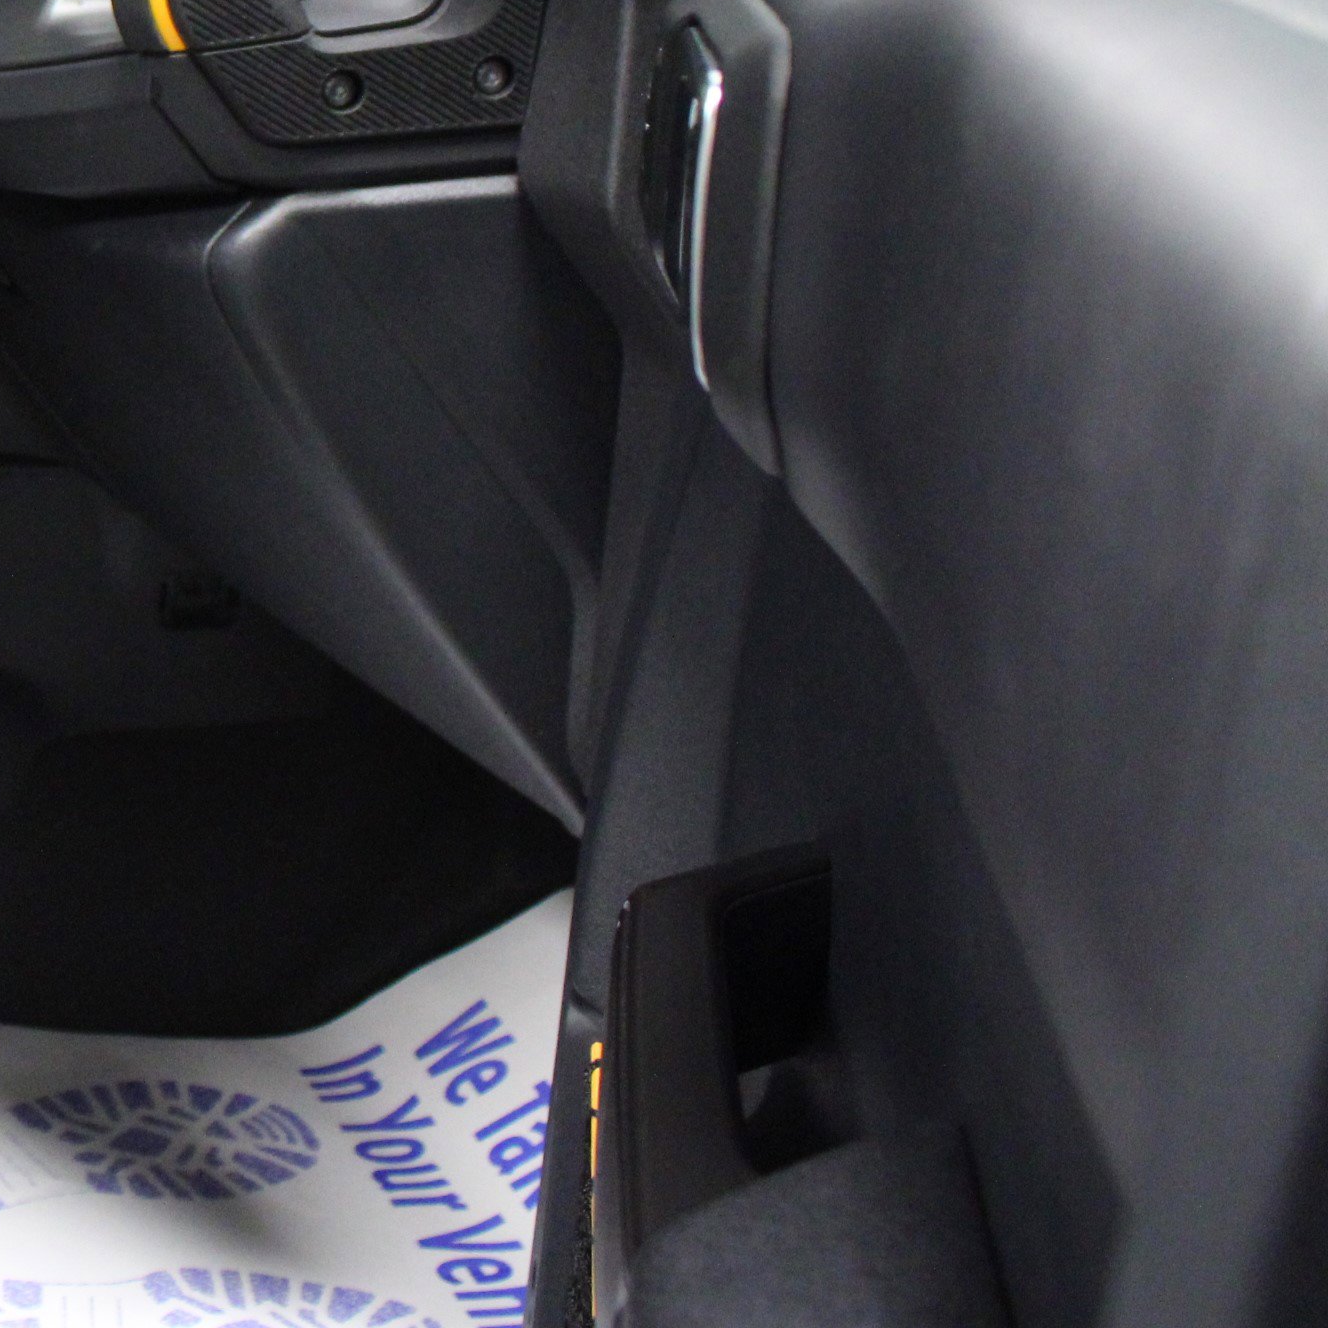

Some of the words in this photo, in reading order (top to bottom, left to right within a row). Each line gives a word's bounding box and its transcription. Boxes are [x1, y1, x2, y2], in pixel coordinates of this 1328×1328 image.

[299, 1044, 386, 1103] In
[414, 998, 516, 1107] We
[339, 1094, 468, 1212] Your
